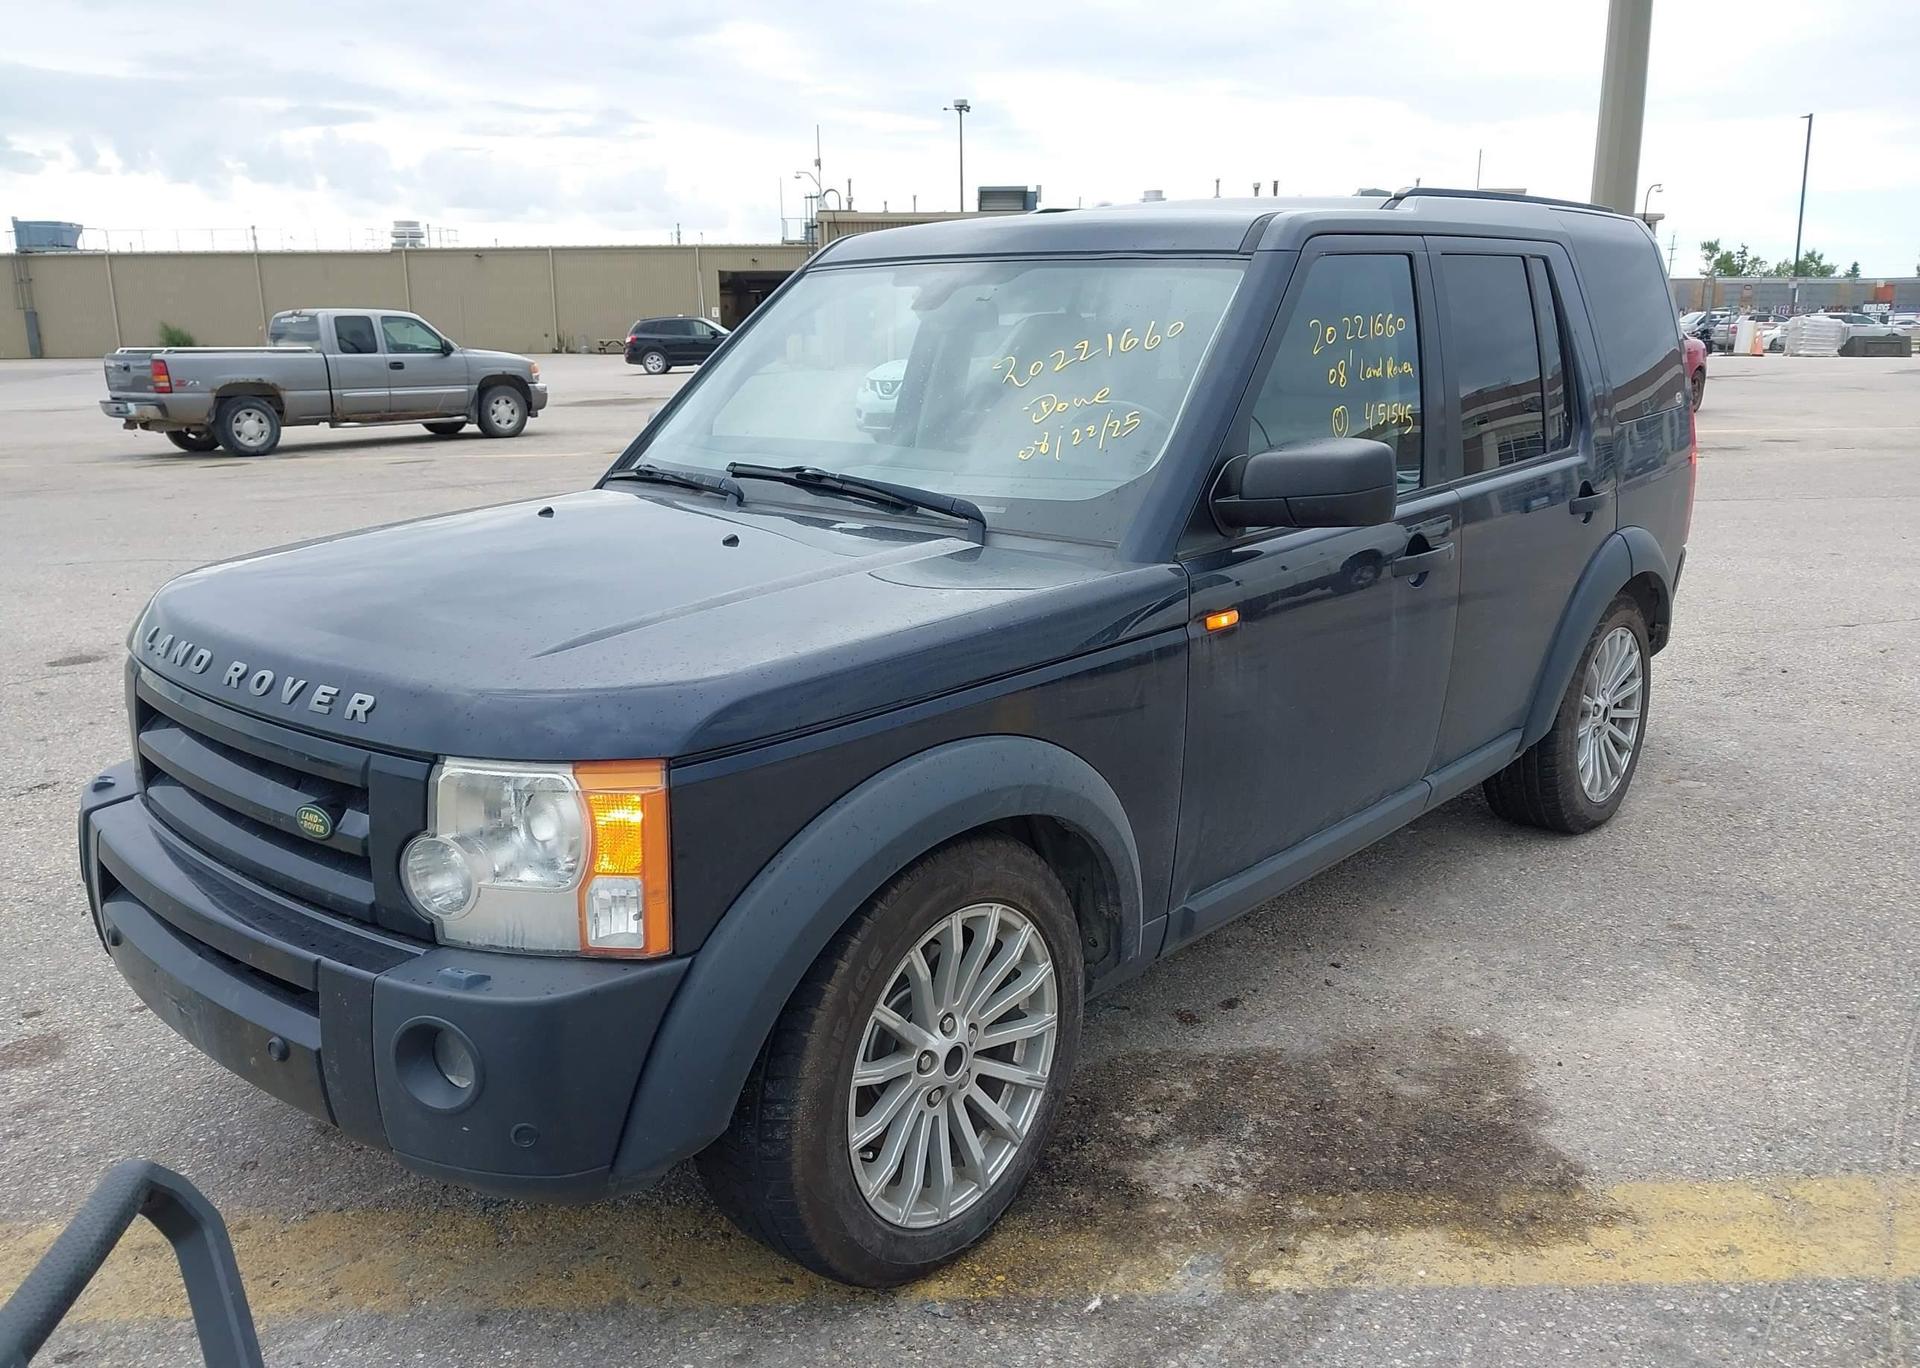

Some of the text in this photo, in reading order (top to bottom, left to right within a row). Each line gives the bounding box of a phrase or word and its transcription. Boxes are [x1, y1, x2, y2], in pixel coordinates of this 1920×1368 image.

[993, 320, 1185, 388] 20221660
[1022, 387, 1111, 424] Done
[145, 626, 377, 724] LAND ROVER
